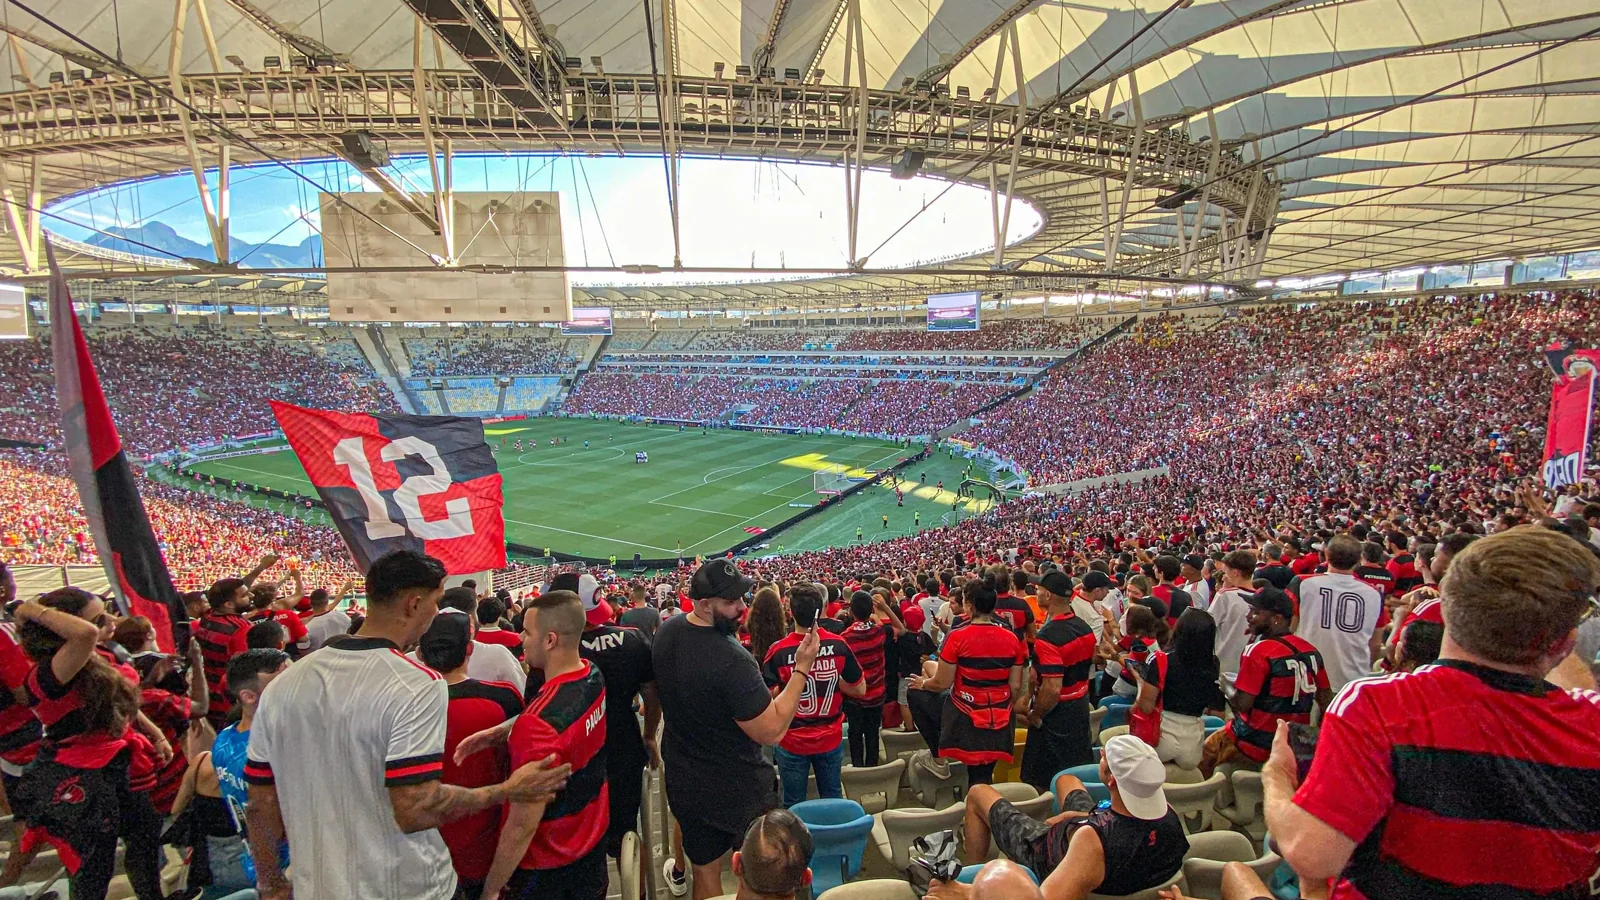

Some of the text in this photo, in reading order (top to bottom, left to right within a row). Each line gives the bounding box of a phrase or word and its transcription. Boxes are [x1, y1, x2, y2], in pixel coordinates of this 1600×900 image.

[333, 436, 475, 540] 12
[1320, 587, 1365, 633] 10
[581, 632, 625, 652] MRV
[797, 669, 838, 716] 97
